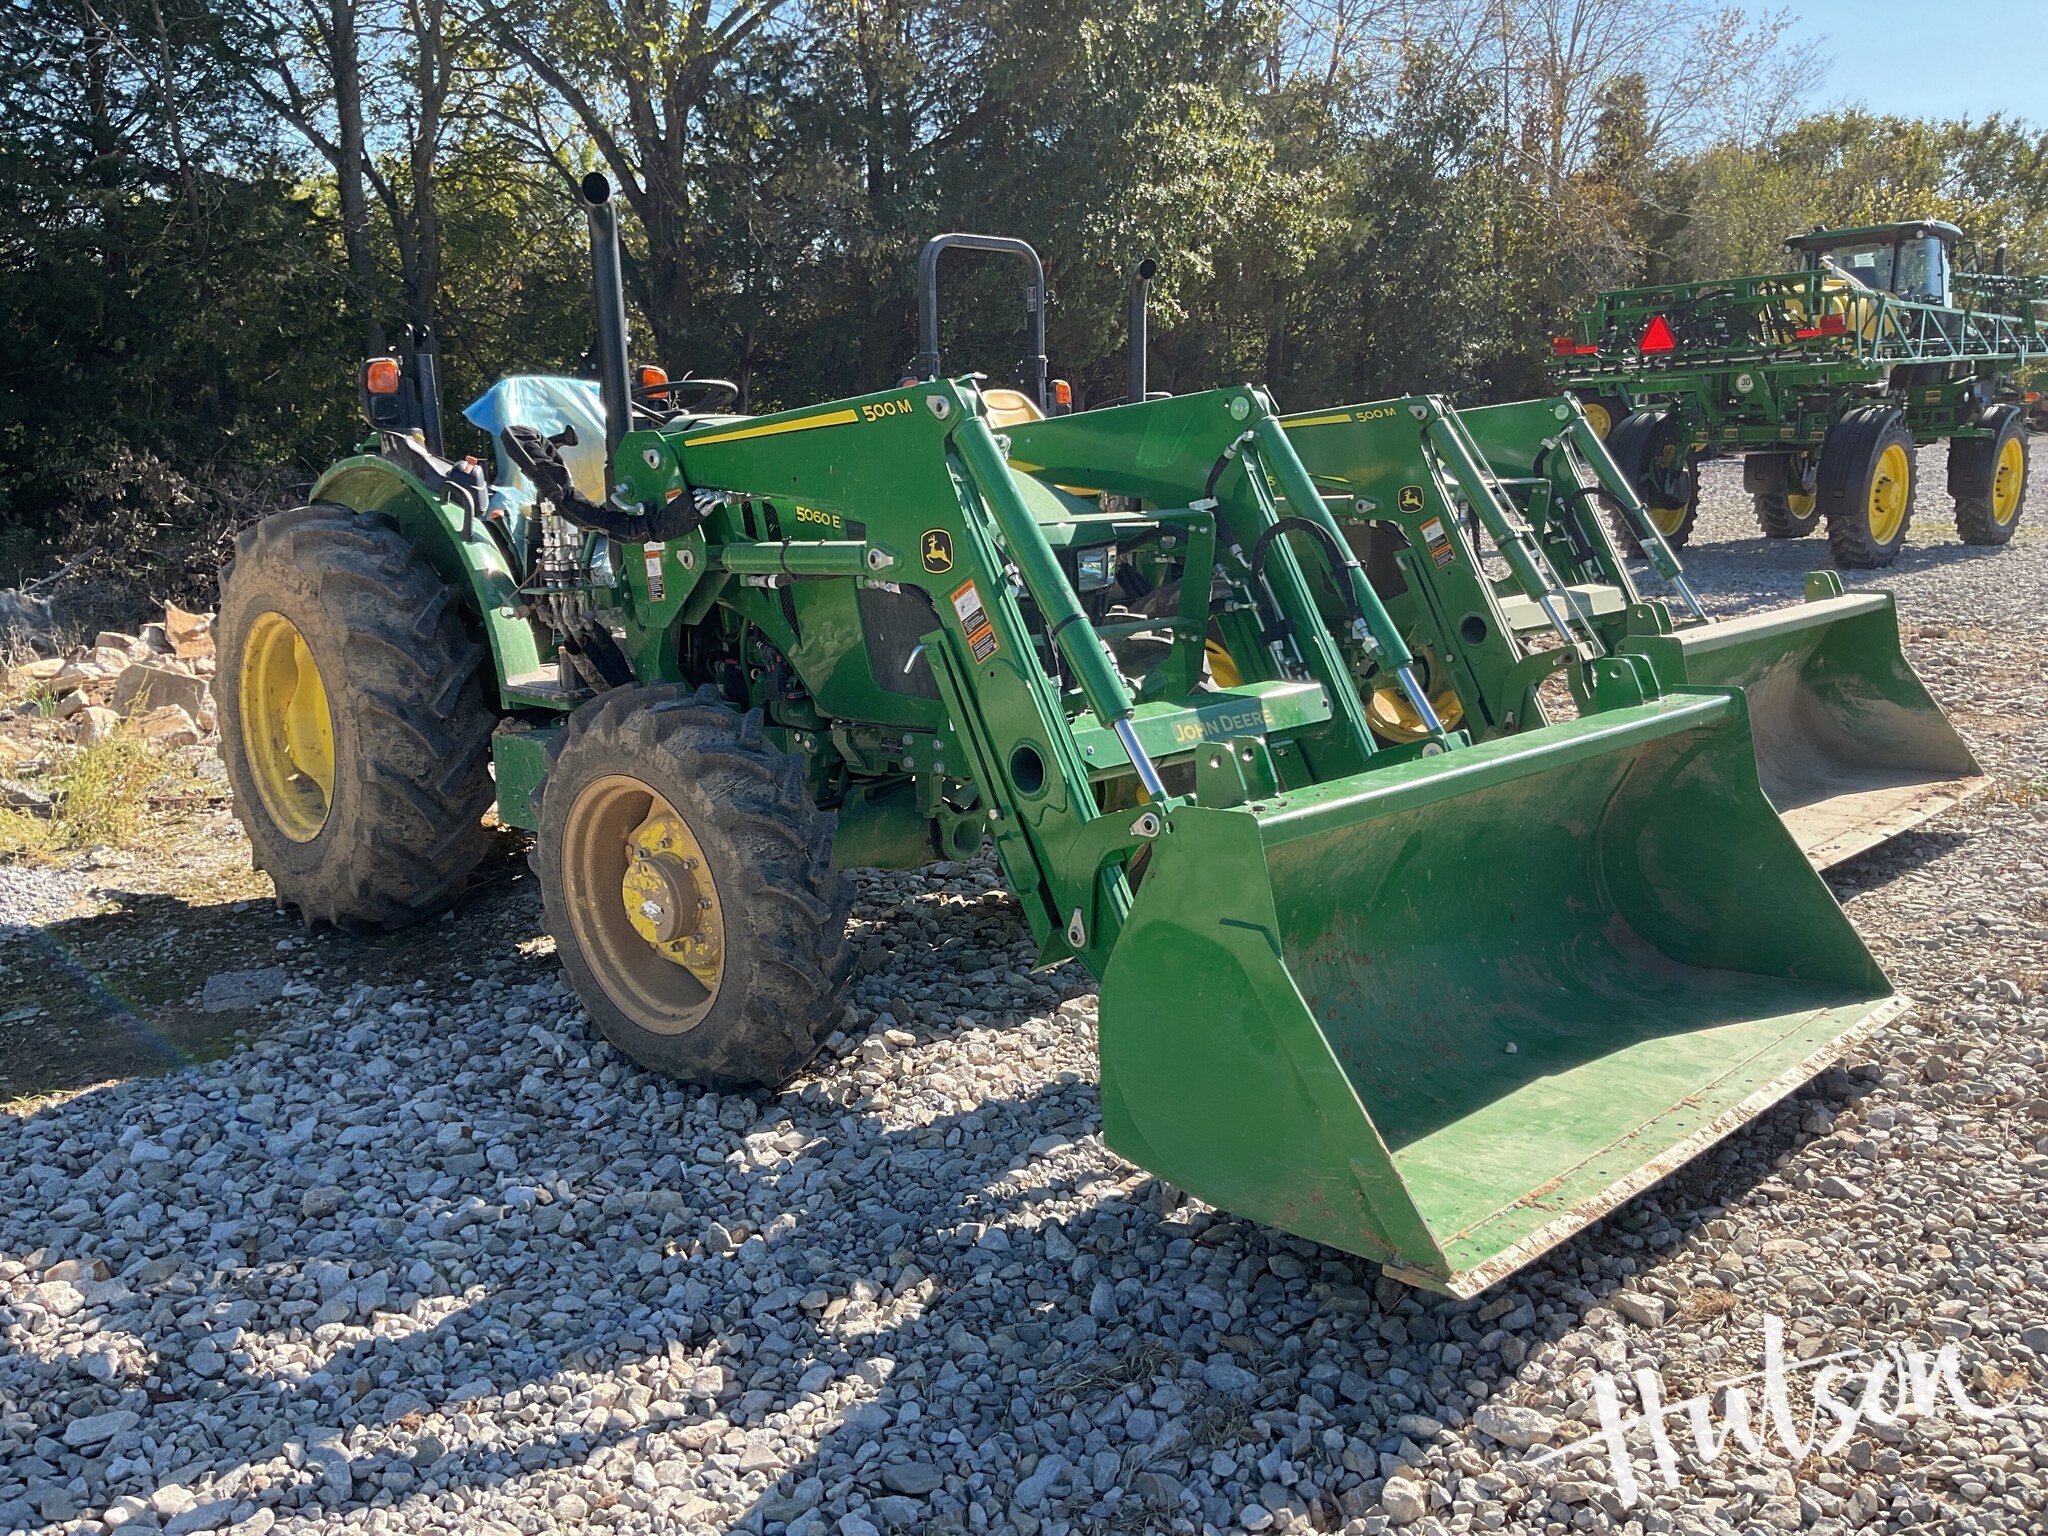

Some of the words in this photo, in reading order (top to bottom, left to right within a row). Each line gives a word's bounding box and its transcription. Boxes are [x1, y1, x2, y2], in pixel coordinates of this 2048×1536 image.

[1741, 378, 1751, 386] 30
[861, 401, 897, 422] 500
[895, 398, 913, 414] M
[1355, 409, 1383, 423] 500
[1383, 407, 1397, 417] M
[795, 505, 831, 526] 5060
[831, 515, 841, 529] E
[1176, 722, 1220, 743] JOHN
[1218, 708, 1274, 733] DEERE
